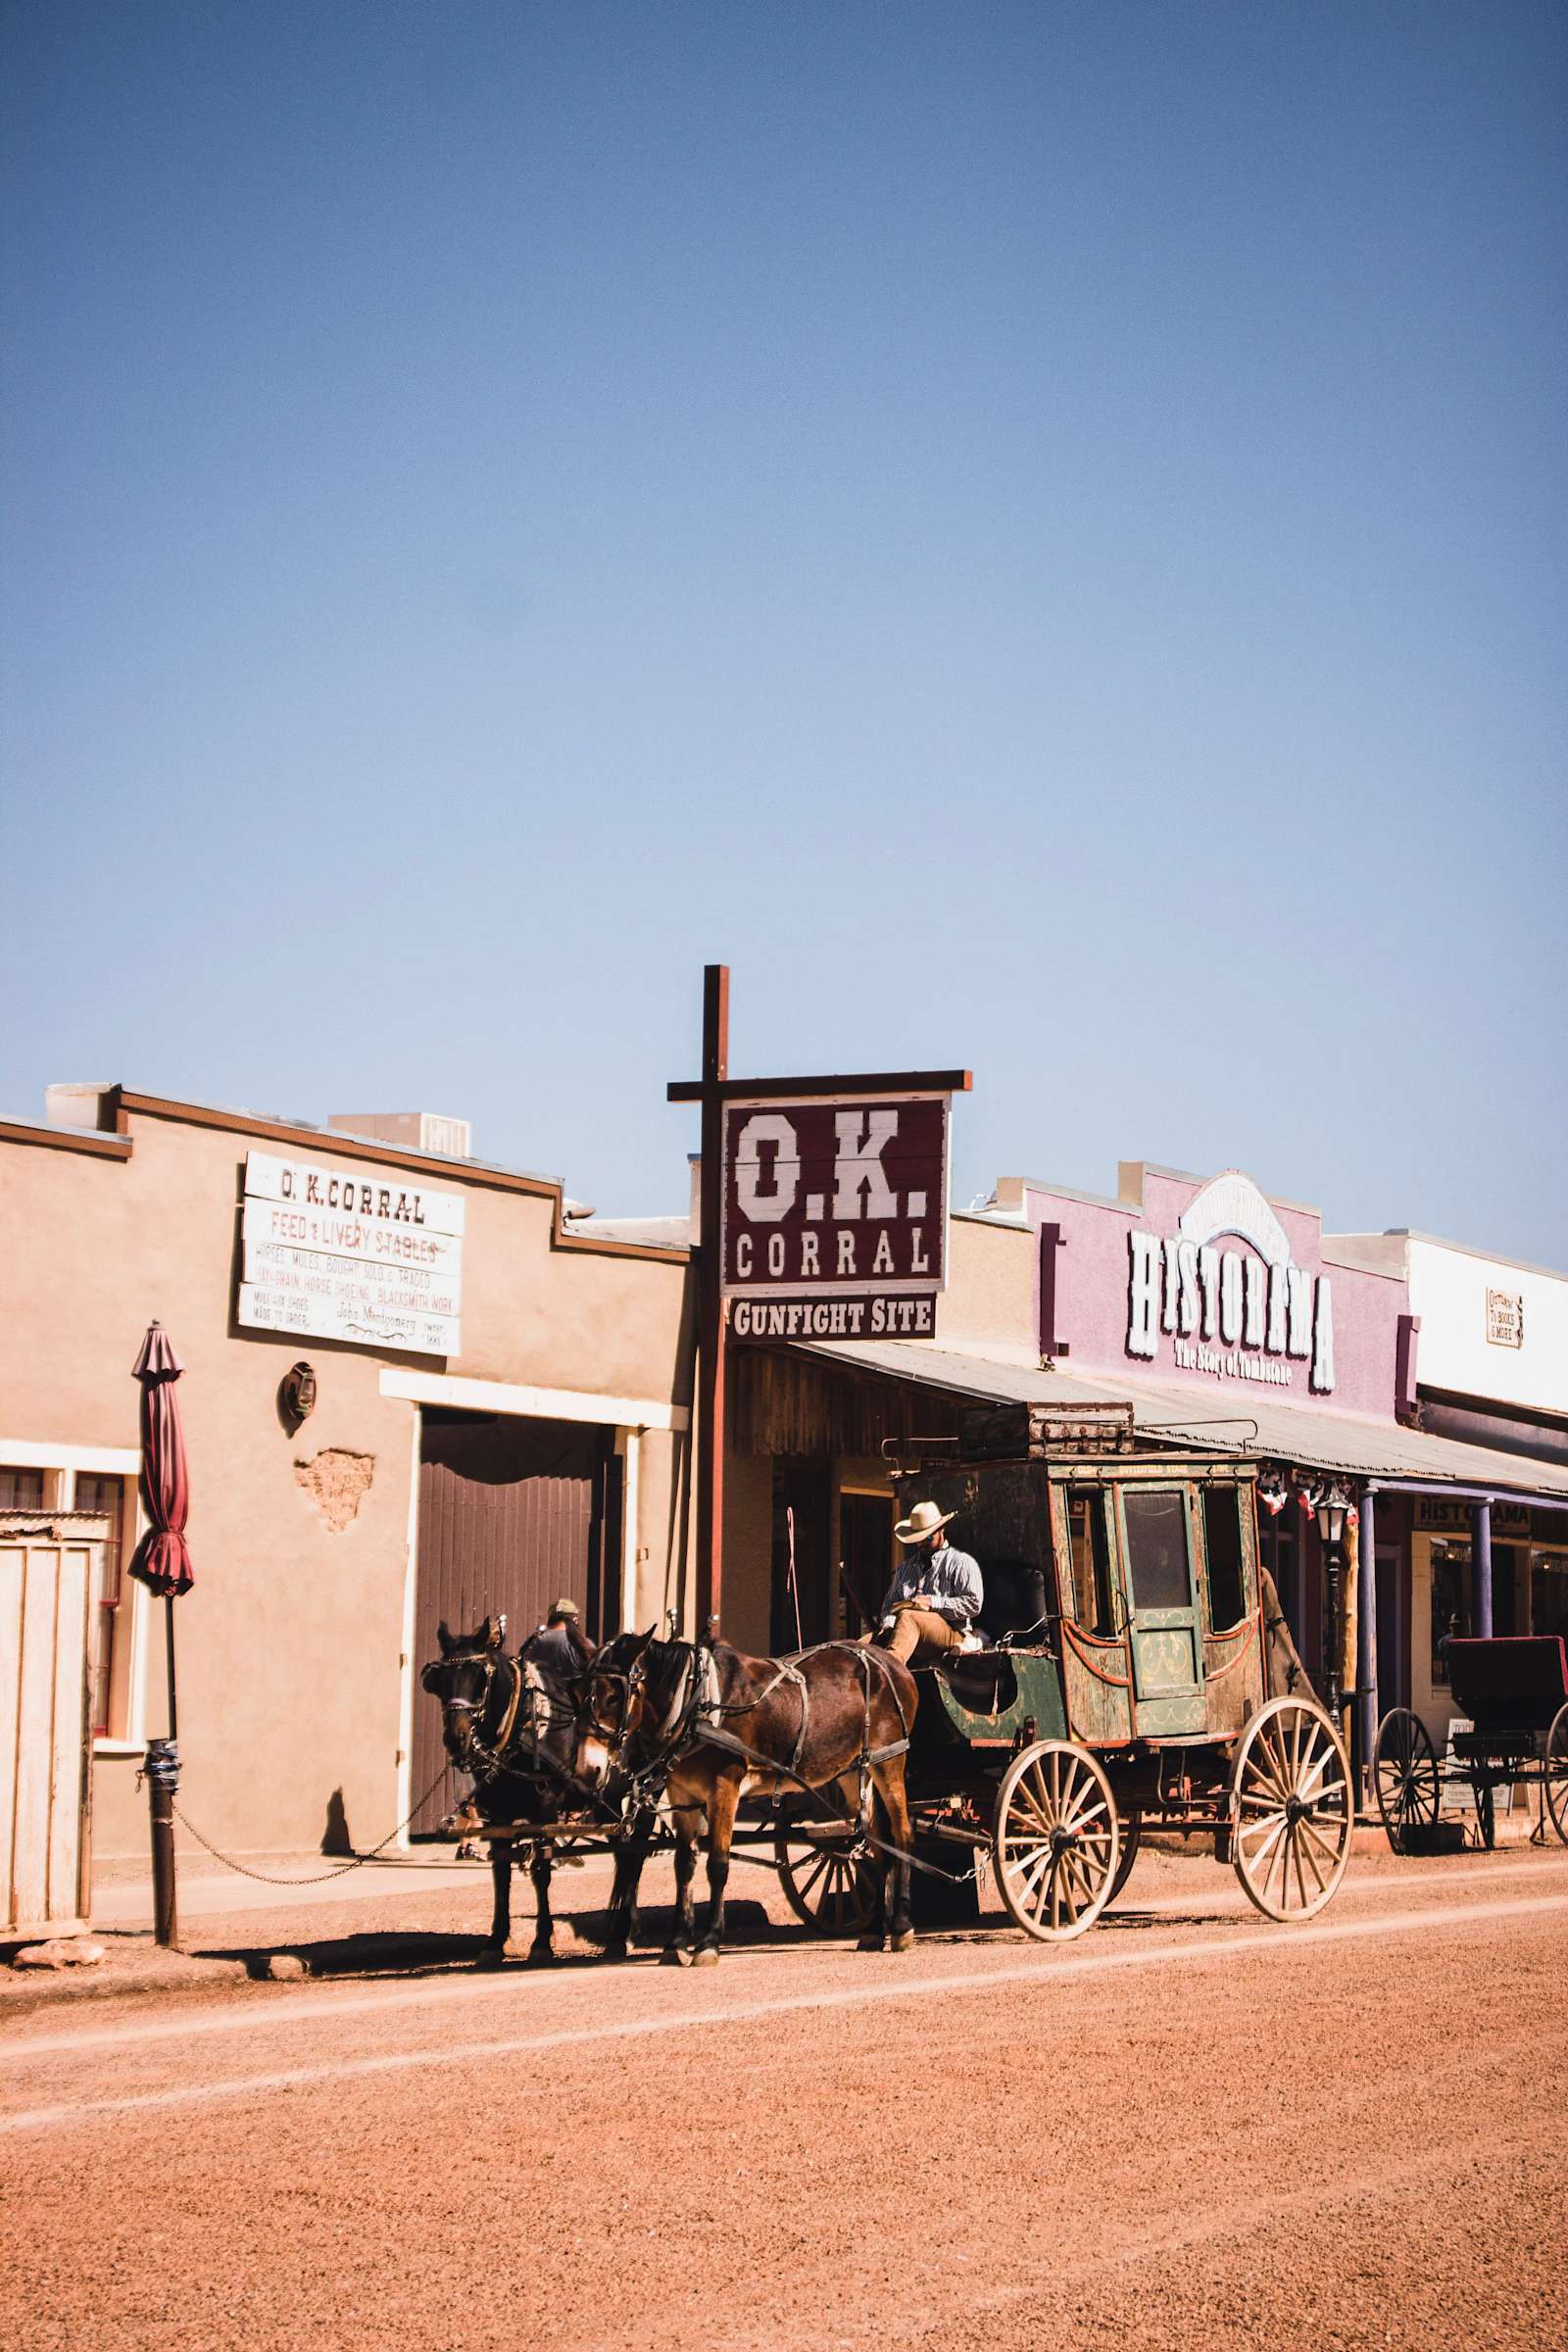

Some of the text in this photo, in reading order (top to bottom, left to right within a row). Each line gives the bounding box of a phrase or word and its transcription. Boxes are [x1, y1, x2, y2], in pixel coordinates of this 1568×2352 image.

[327, 1179, 425, 1225] CORRAL
[270, 1211, 306, 1240] FEED
[321, 1219, 370, 1253] LIVERY
[376, 1231, 437, 1263] STABLES
[736, 1227, 929, 1278] CORRAL
[304, 1275, 332, 1296] HORSE
[377, 1288, 428, 1309] BLACKSMITH
[400, 1268, 431, 1289] TRADED
[734, 1298, 932, 1336] GUNFIGHT SITE
[1130, 1230, 1335, 1393] HISTORAMA
[1498, 1311, 1514, 1326] BOOKS
[1496, 1326, 1512, 1340] MORE
[1175, 1339, 1293, 1386] The Story of Tombstone
[1420, 1501, 1529, 1523] HISTOAMA
